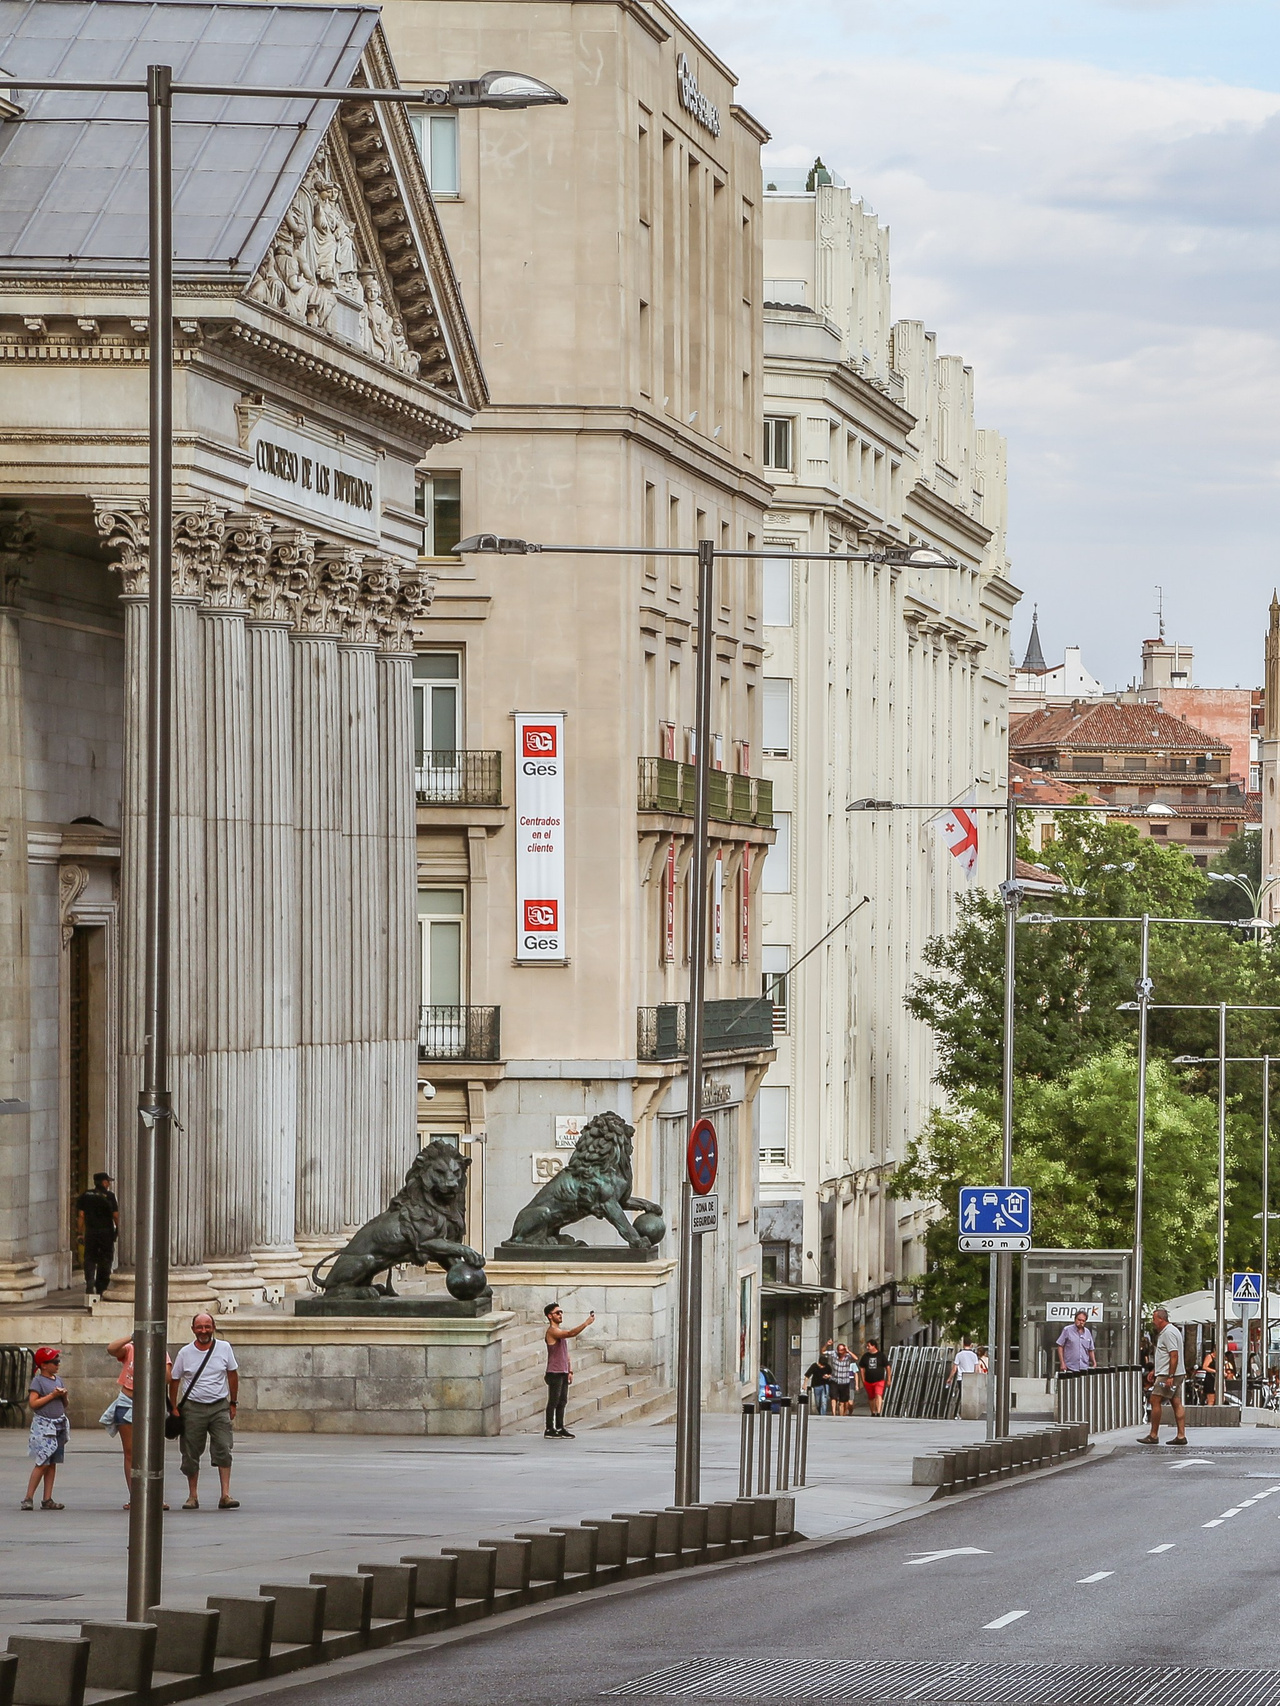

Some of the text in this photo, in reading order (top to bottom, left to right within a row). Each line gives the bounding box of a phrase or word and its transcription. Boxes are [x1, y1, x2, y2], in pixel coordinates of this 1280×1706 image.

[256, 439, 373, 512] CONGRESO DE LOS DIPUTADOS
[522, 761, 558, 777] Ges
[519, 816, 561, 826] Centrados
[532, 829, 552, 840] en el
[527, 842, 554, 853] cliente
[524, 935, 559, 950] Ges
[695, 1200, 715, 1214] ZONA DE
[693, 1214, 717, 1228] SEGURIDAD
[981, 1239, 1008, 1248] 20 m
